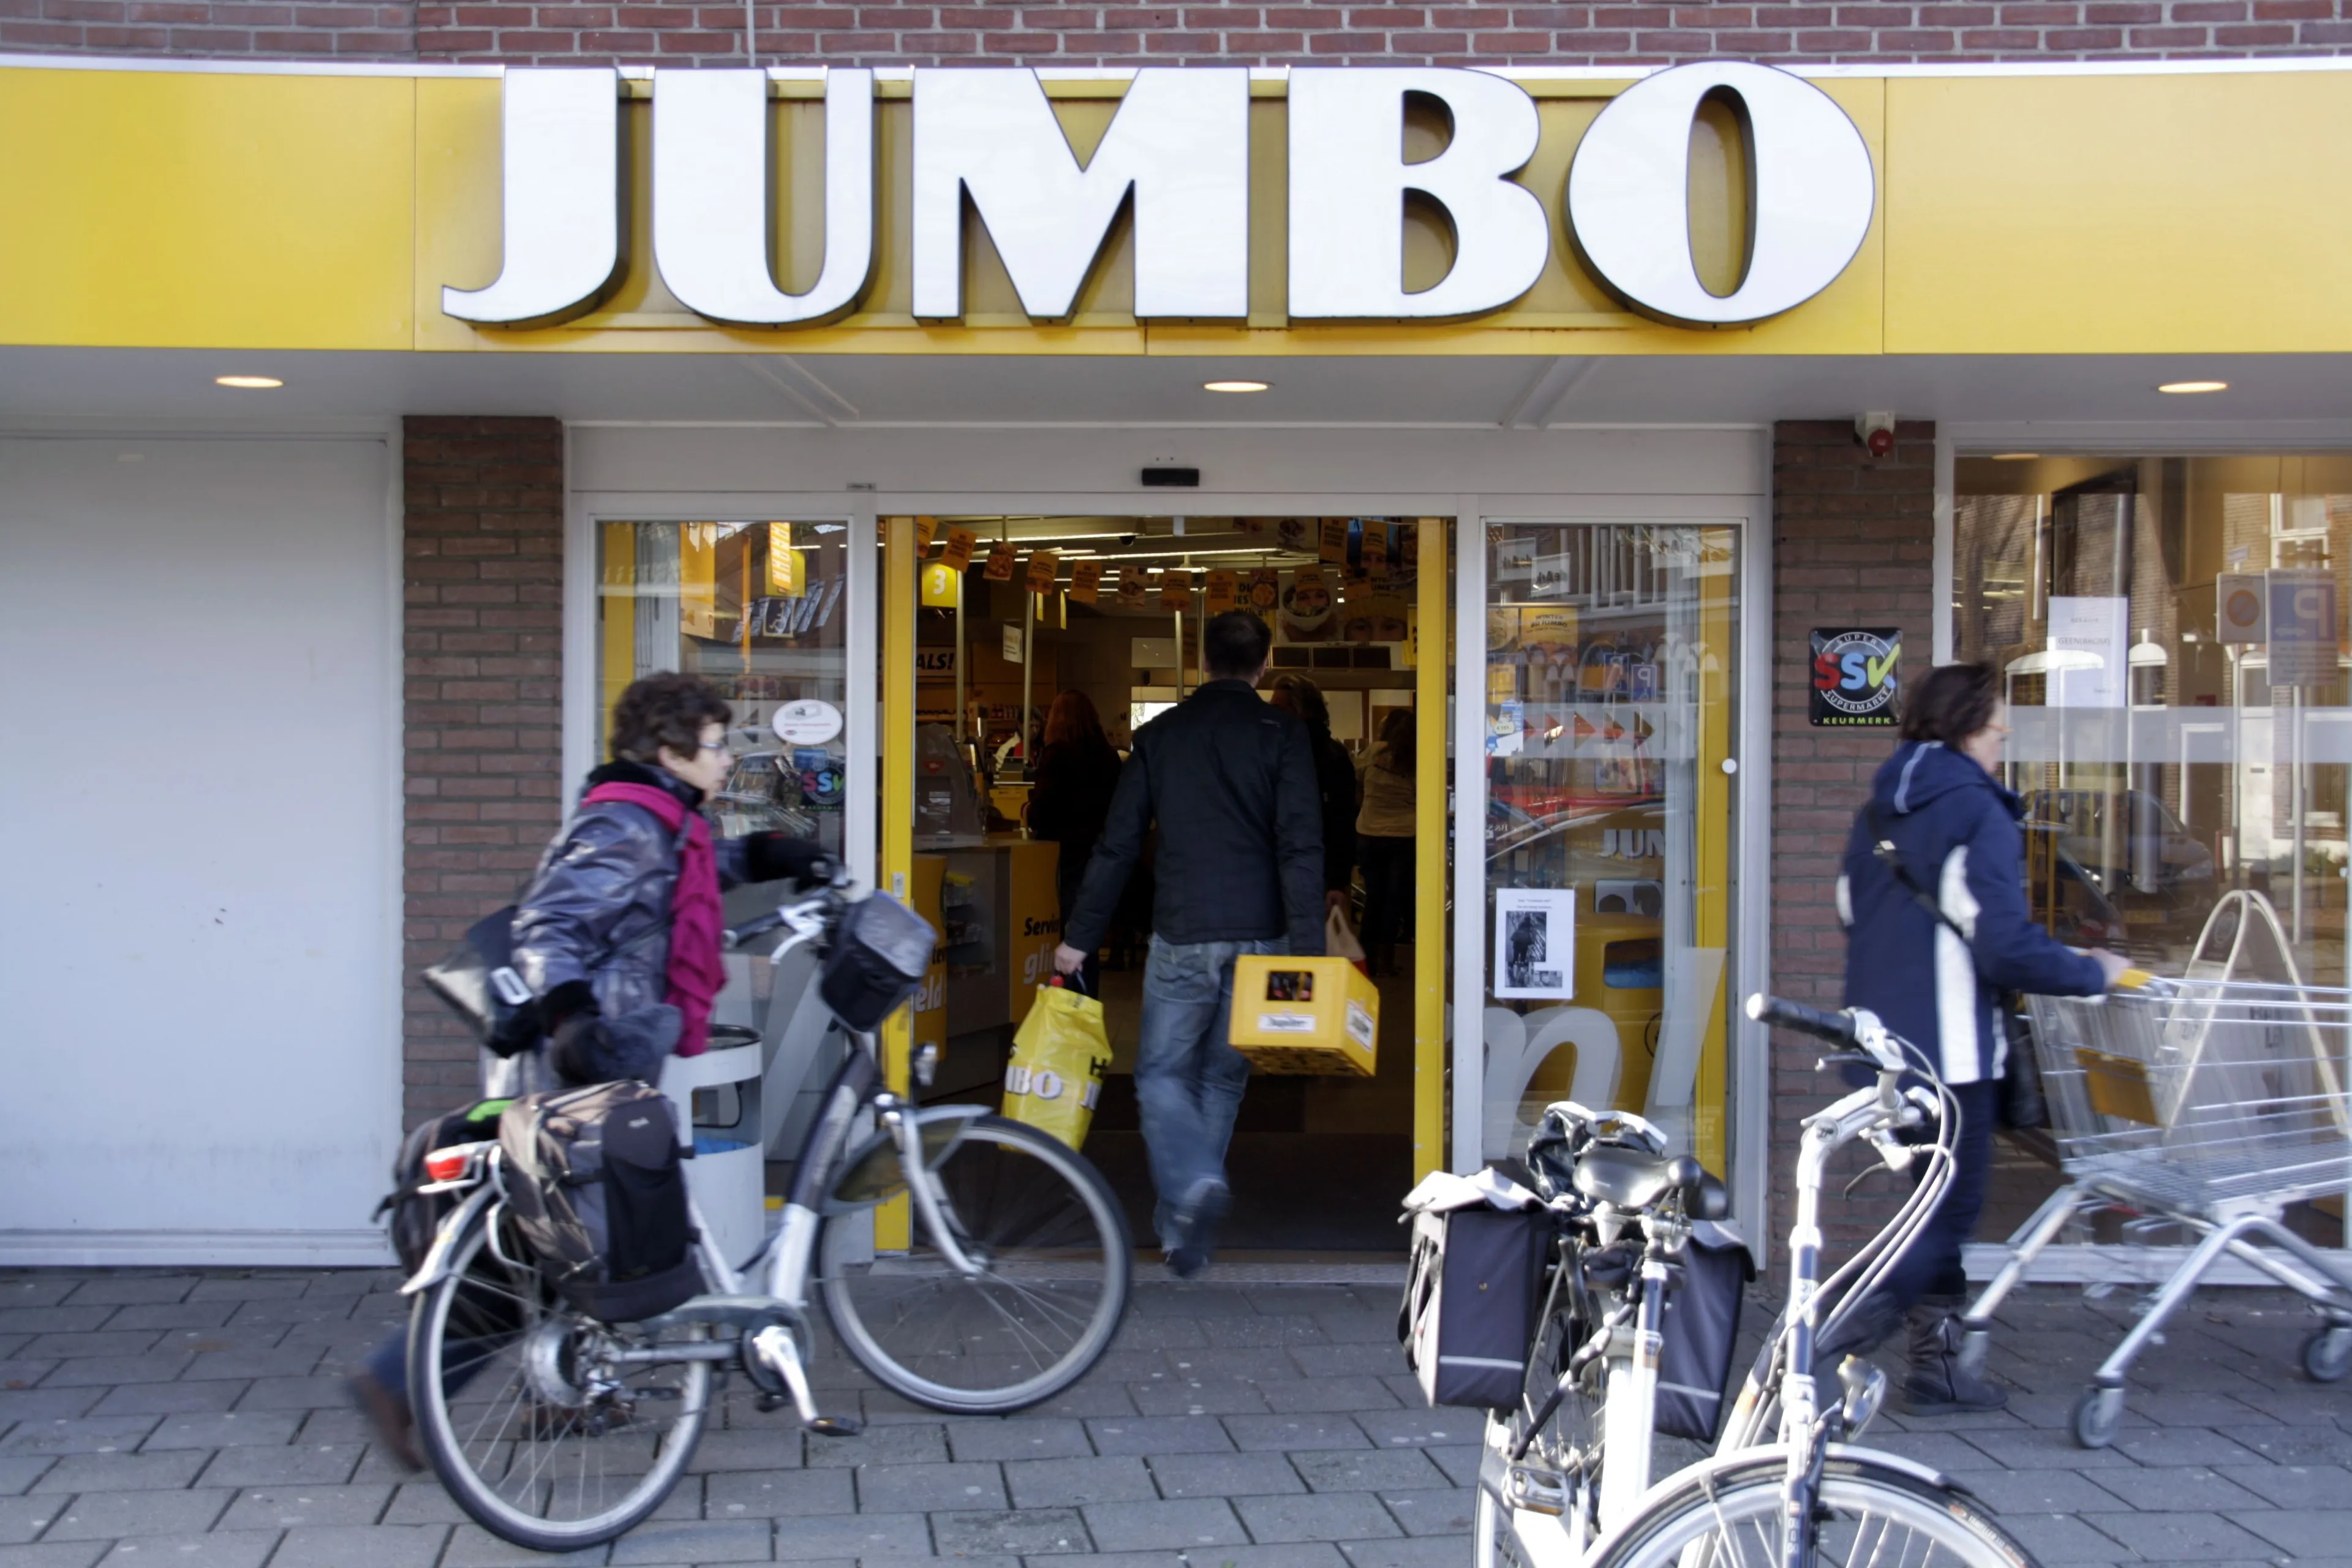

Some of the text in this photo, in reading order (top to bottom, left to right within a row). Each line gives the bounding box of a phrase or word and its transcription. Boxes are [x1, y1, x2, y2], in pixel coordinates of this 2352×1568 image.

[441, 61, 1875, 326] JUMBO
[932, 569, 947, 595] 3
[1836, 633, 1877, 646] SUPER
[1825, 690, 1890, 711] SUPERMARKT
